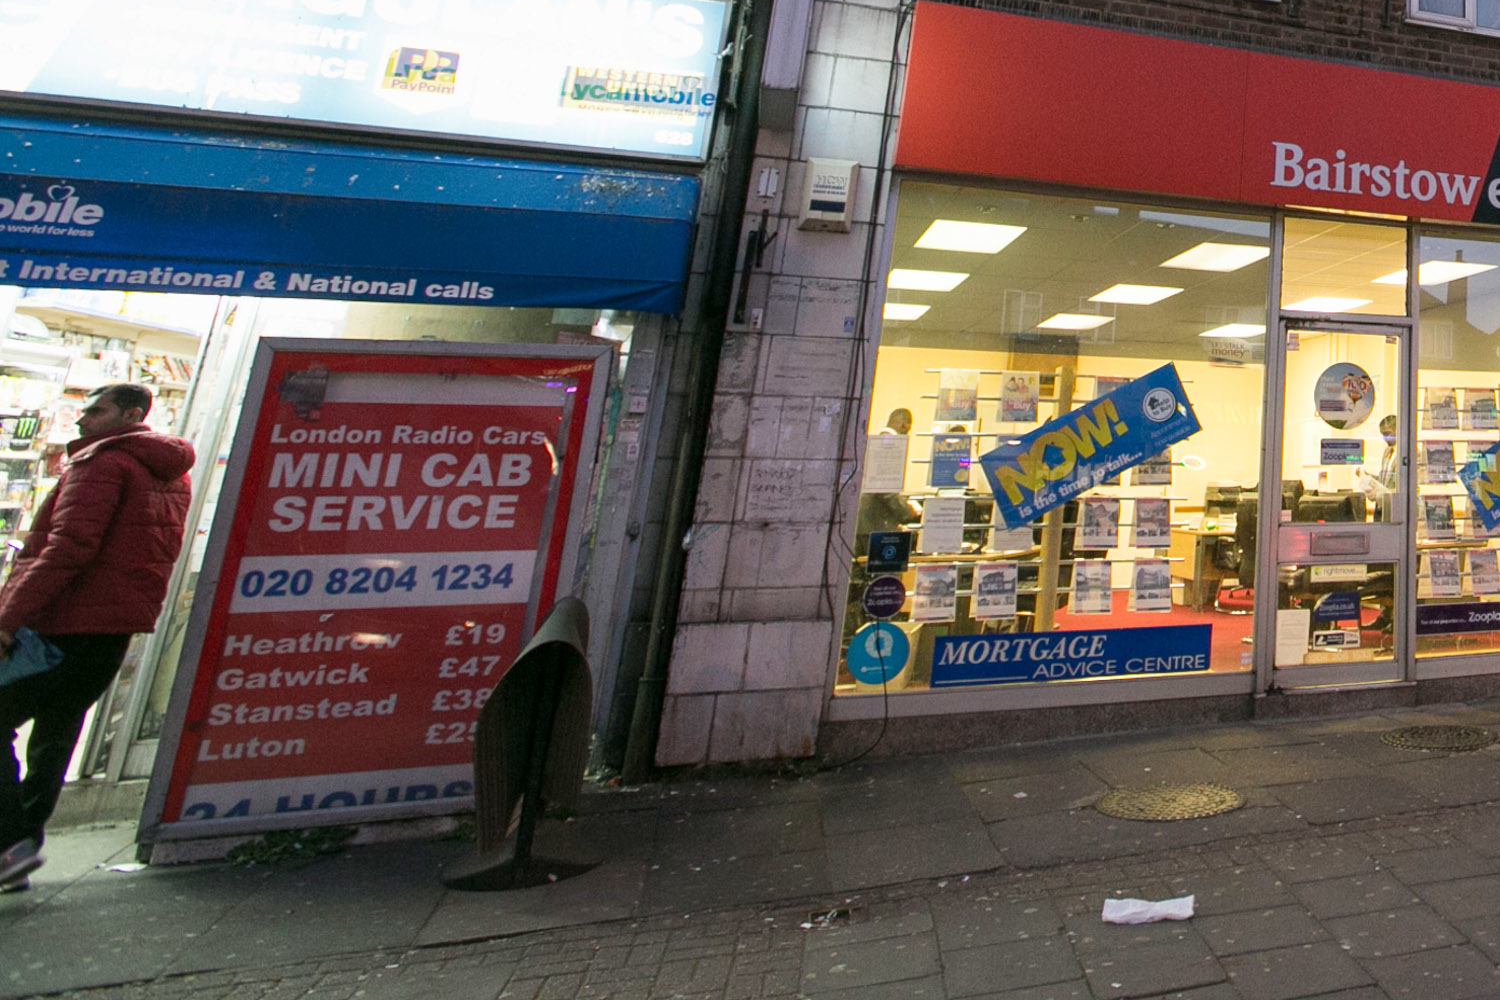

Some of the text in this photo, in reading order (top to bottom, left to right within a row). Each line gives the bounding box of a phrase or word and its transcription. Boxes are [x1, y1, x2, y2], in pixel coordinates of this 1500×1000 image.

[391, 79, 455, 96] PayPoint
[1270, 141, 1480, 205] Bairstow
[7, 225, 46, 234] world
[67, 228, 95, 237] less
[18, 260, 243, 289] International
[253, 271, 276, 290] &
[287, 272, 416, 298] National
[425, 281, 494, 299] calls
[1211, 348, 1245, 358] money
[1014, 400, 1032, 411] Buy
[270, 424, 546, 445] London Radio Cars
[994, 398, 1129, 505] NOW!
[1323, 452, 1350, 462] Zoopl
[268, 453, 532, 488] MINI CAB
[1018, 451, 1143, 519] is the time to talk...
[268, 494, 519, 532] SERVICE
[240, 563, 514, 598] 020 8204 1234
[223, 623, 506, 657] Heathrow £19
[938, 634, 1108, 666] MORTGAGE
[216, 655, 501, 691] Gatwick £47
[1032, 654, 1206, 680] ADVICE CENTRE
[207, 694, 398, 726] Stanstead
[197, 738, 305, 761] Luton
